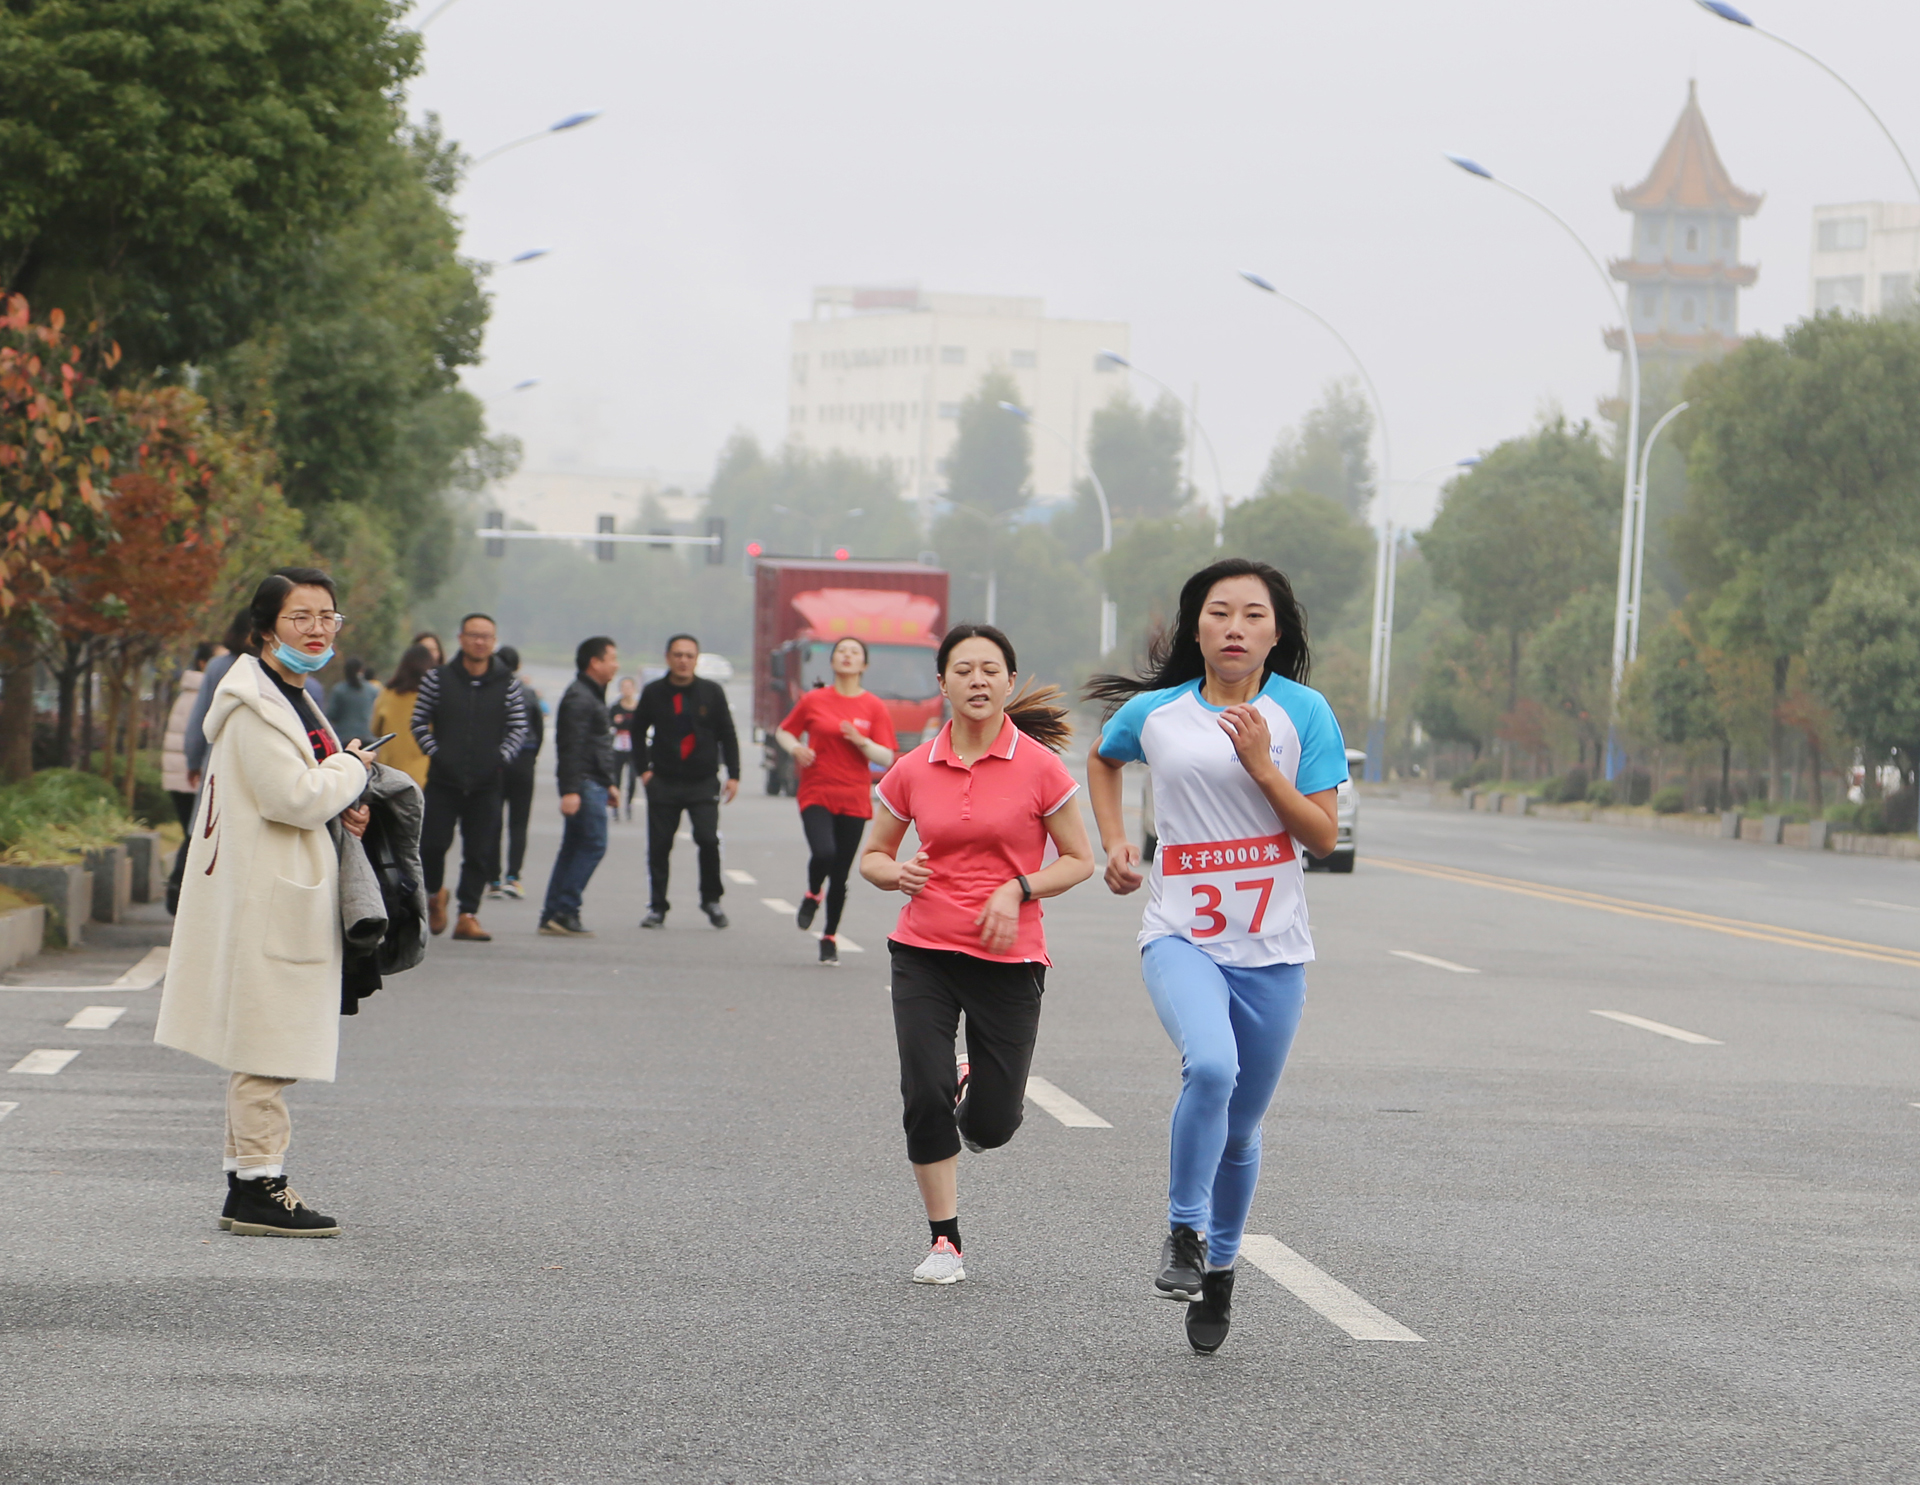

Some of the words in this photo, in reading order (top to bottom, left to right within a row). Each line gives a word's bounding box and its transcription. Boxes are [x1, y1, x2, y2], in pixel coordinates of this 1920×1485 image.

[1179, 843, 1281, 871] 女子3000米
[1191, 877, 1275, 938] 37
